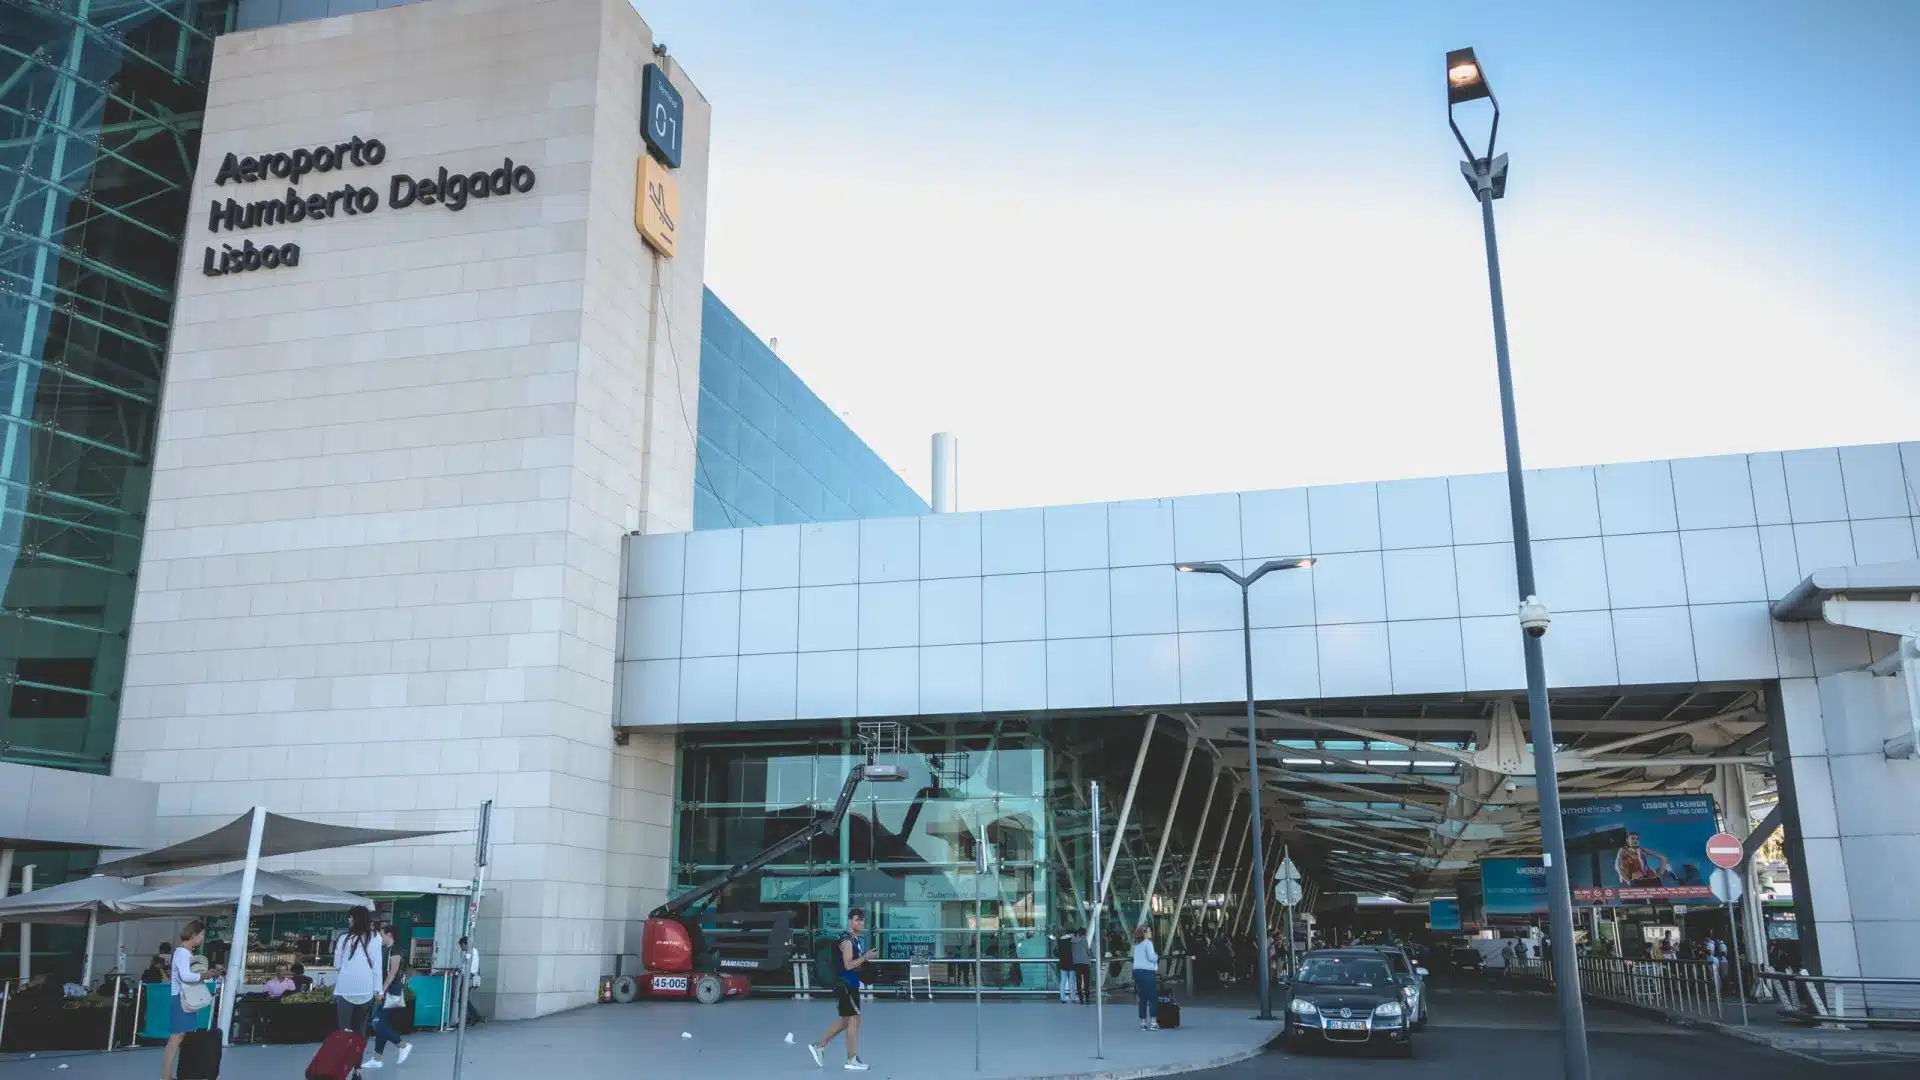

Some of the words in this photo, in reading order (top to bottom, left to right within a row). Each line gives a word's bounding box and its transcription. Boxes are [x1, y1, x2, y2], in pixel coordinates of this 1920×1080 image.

[656, 103, 676, 150] 01
[214, 134, 386, 186] Aeroporto
[208, 182, 379, 234] Humberto
[388, 156, 536, 212] Delgado
[202, 239, 301, 278] Lisboa
[1561, 804, 1612, 815] amoreiras
[1676, 800, 1707, 808] FASHION
[891, 933, 908, 941] with
[910, 933, 936, 942] them?
[913, 945, 929, 953] you
[654, 978, 687, 988] 45-005
